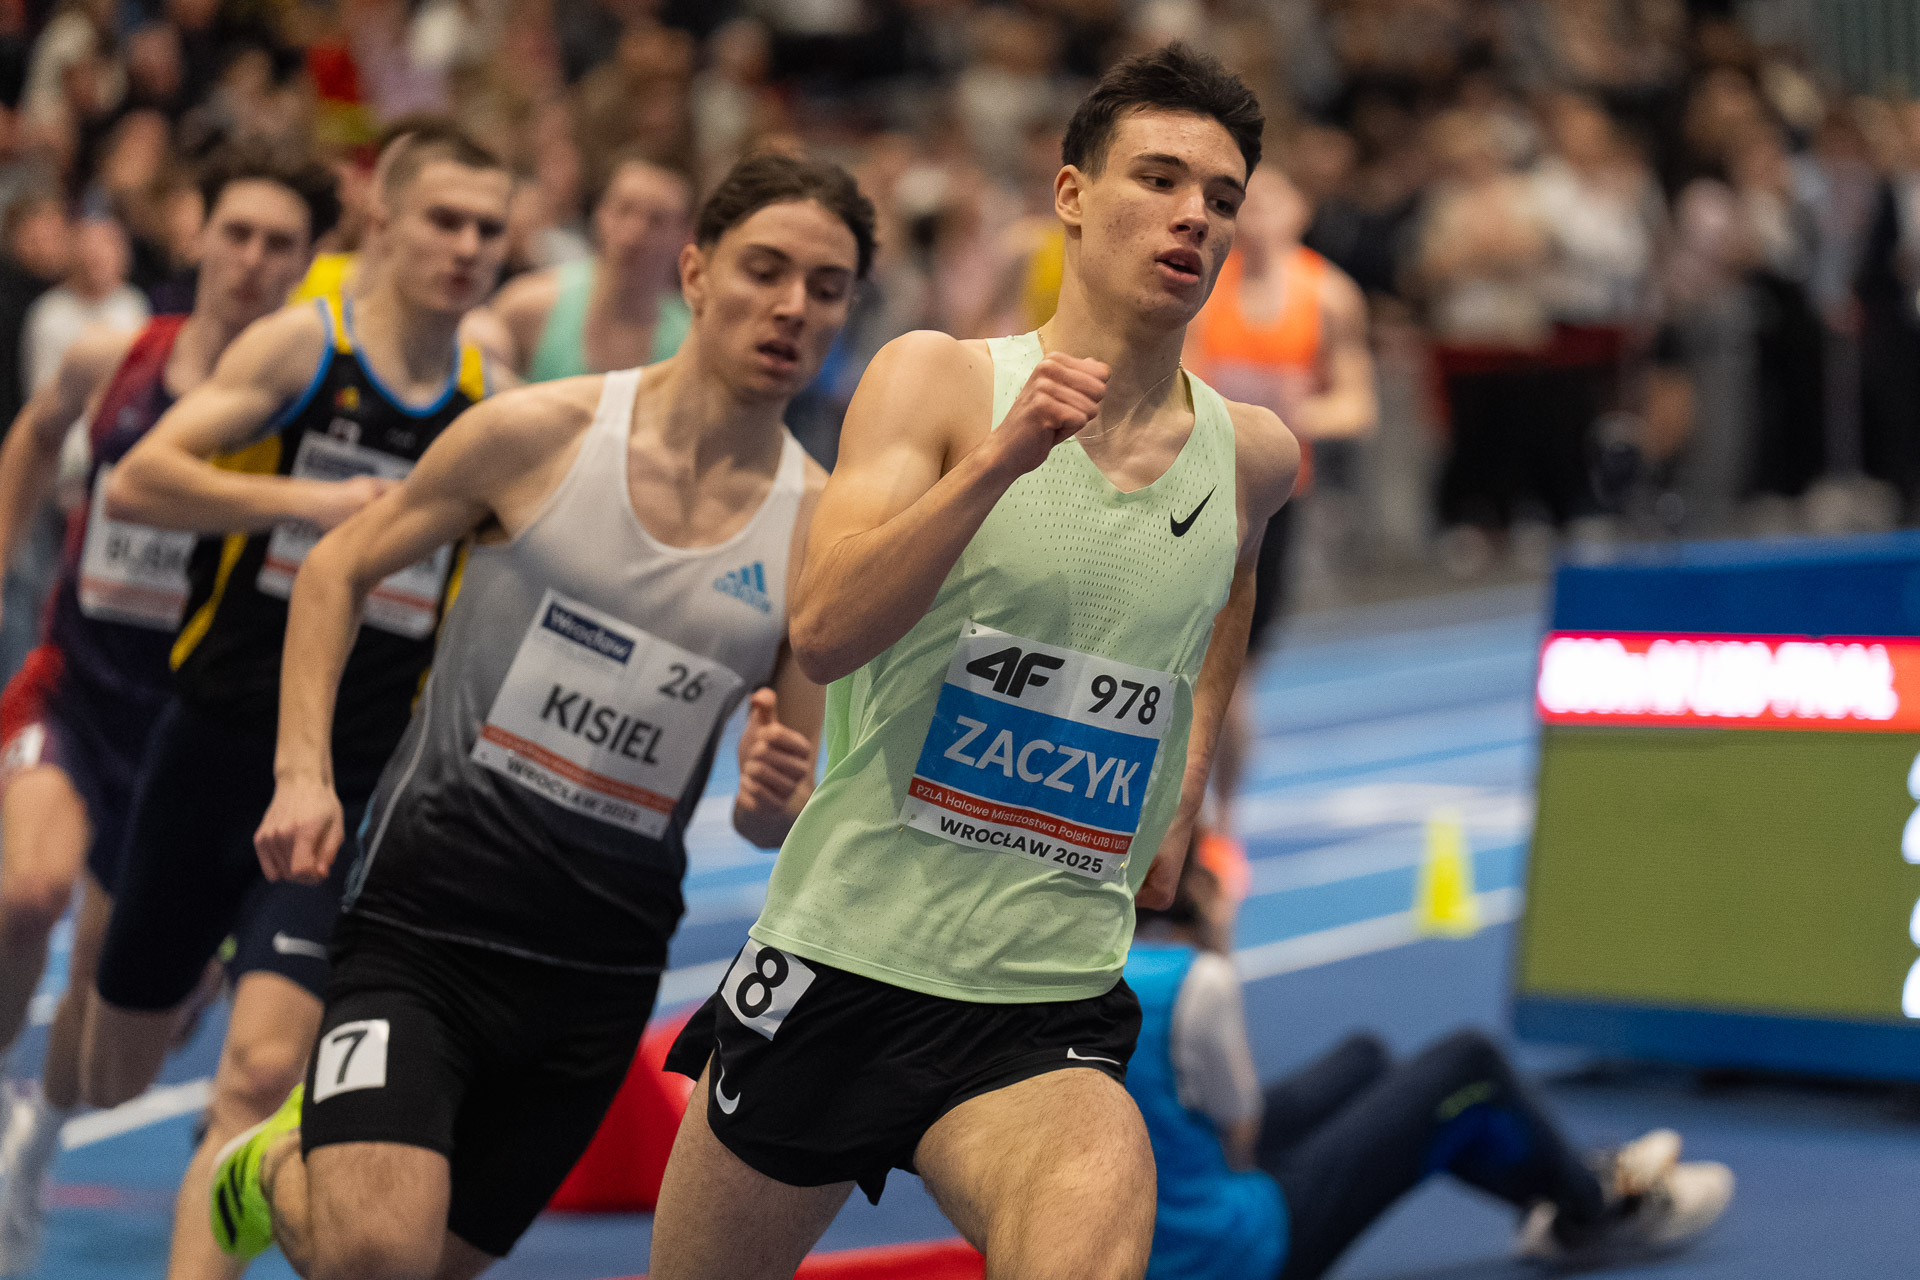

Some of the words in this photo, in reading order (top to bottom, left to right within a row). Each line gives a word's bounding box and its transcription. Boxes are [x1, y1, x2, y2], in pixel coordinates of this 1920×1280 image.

[659, 663, 707, 701] 26
[966, 647, 1065, 698] 4F
[1088, 675, 1160, 725] 978
[541, 685, 663, 765] KISIEL
[944, 716, 1140, 806] ZACZYK
[916, 785, 942, 802] PZLA
[946, 795, 989, 817] Halowe
[991, 810, 1056, 833] Mistrzostwa
[940, 816, 1052, 857] WROCŁAW
[1053, 848, 1104, 874] 2025
[736, 946, 790, 1019] 8
[332, 1029, 369, 1085] 7
